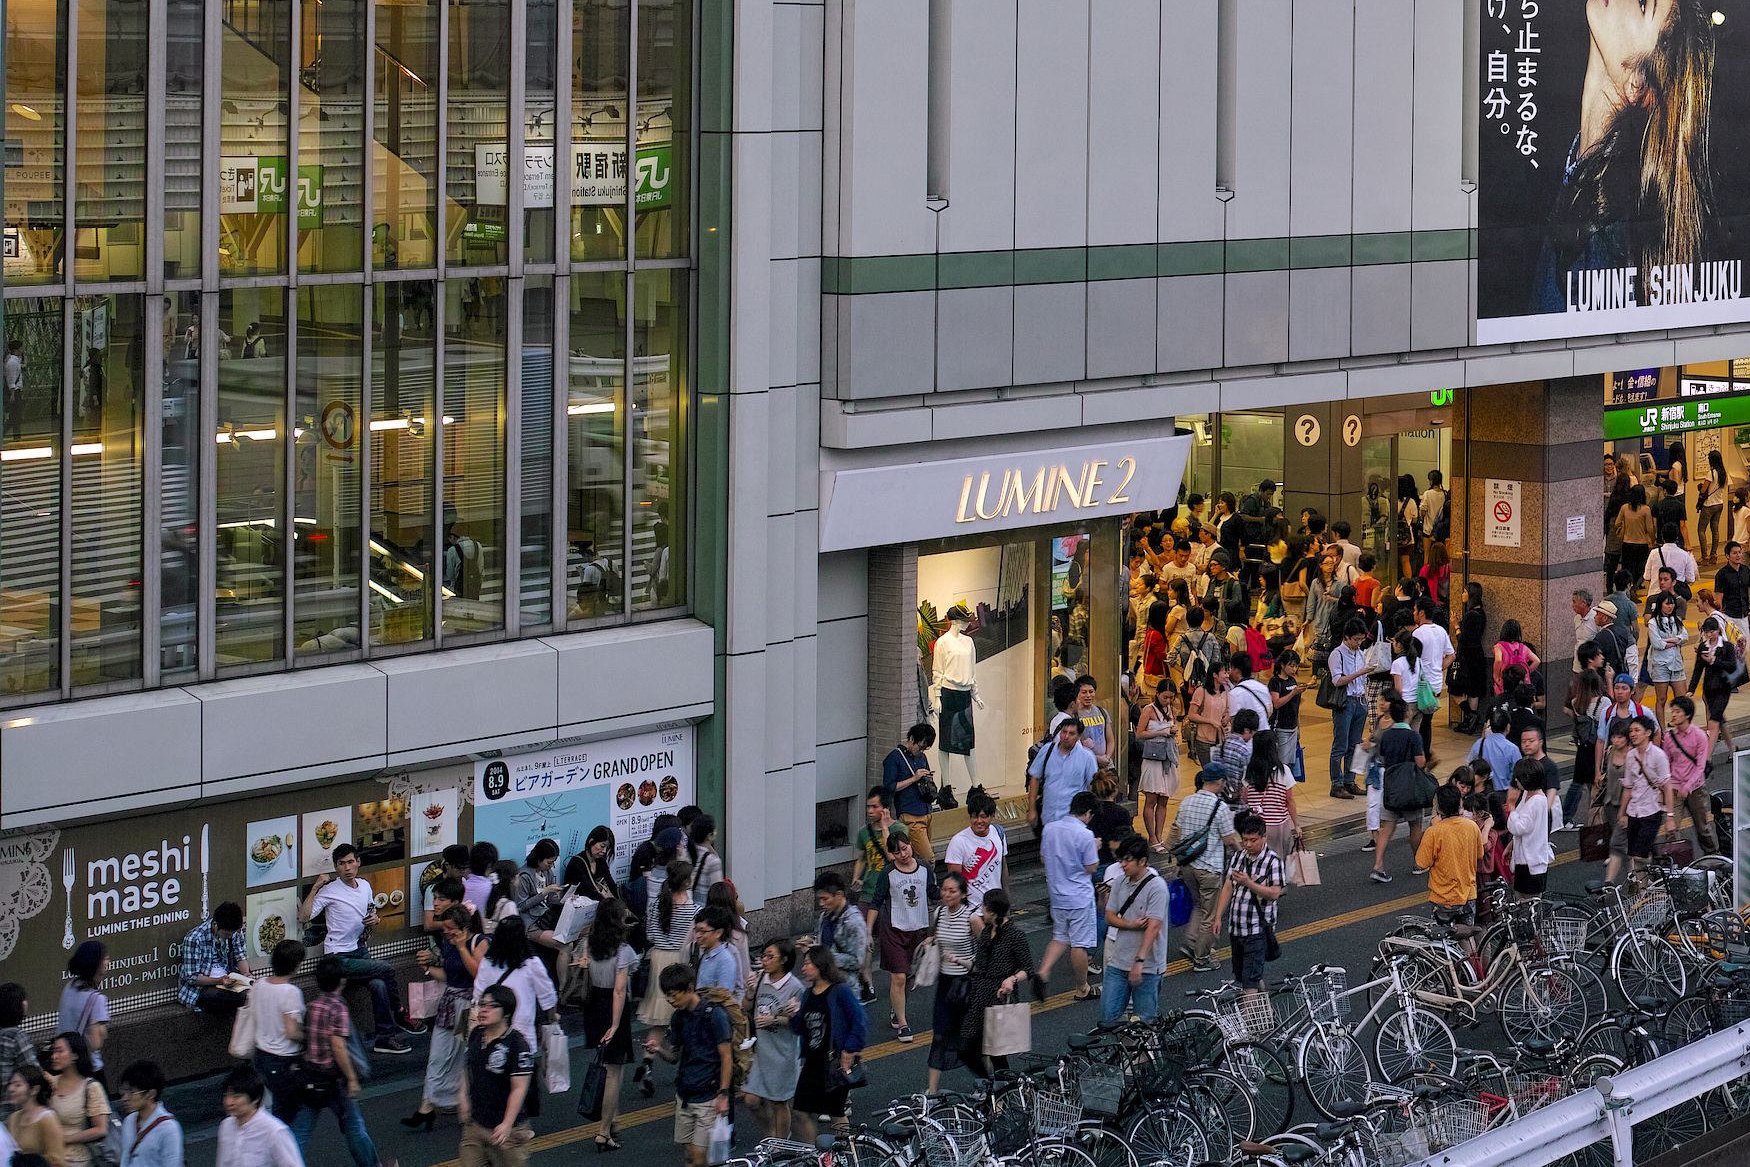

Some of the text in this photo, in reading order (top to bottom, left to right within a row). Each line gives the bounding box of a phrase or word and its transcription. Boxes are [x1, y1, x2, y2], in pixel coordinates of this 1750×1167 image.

[1566, 267, 1638, 312] LUMINE
[1650, 260, 1742, 306] SHINJUKU
[1640, 408, 1658, 426] JR
[1661, 405, 1685, 420] 新宿駅
[956, 455, 1137, 524] LUMINE 2
[661, 733, 684, 745] LUMINE
[515, 766, 591, 792] ビアガーデン
[593, 750, 674, 780] GRAND OPEN
[489, 775, 504, 789] 8.9
[631, 815, 641, 825] 8.9
[87, 835, 191, 887] meshi
[971, 859, 1002, 890] SUEDE
[87, 877, 181, 919] mase
[87, 909, 190, 938] LUMINE THE DINING
